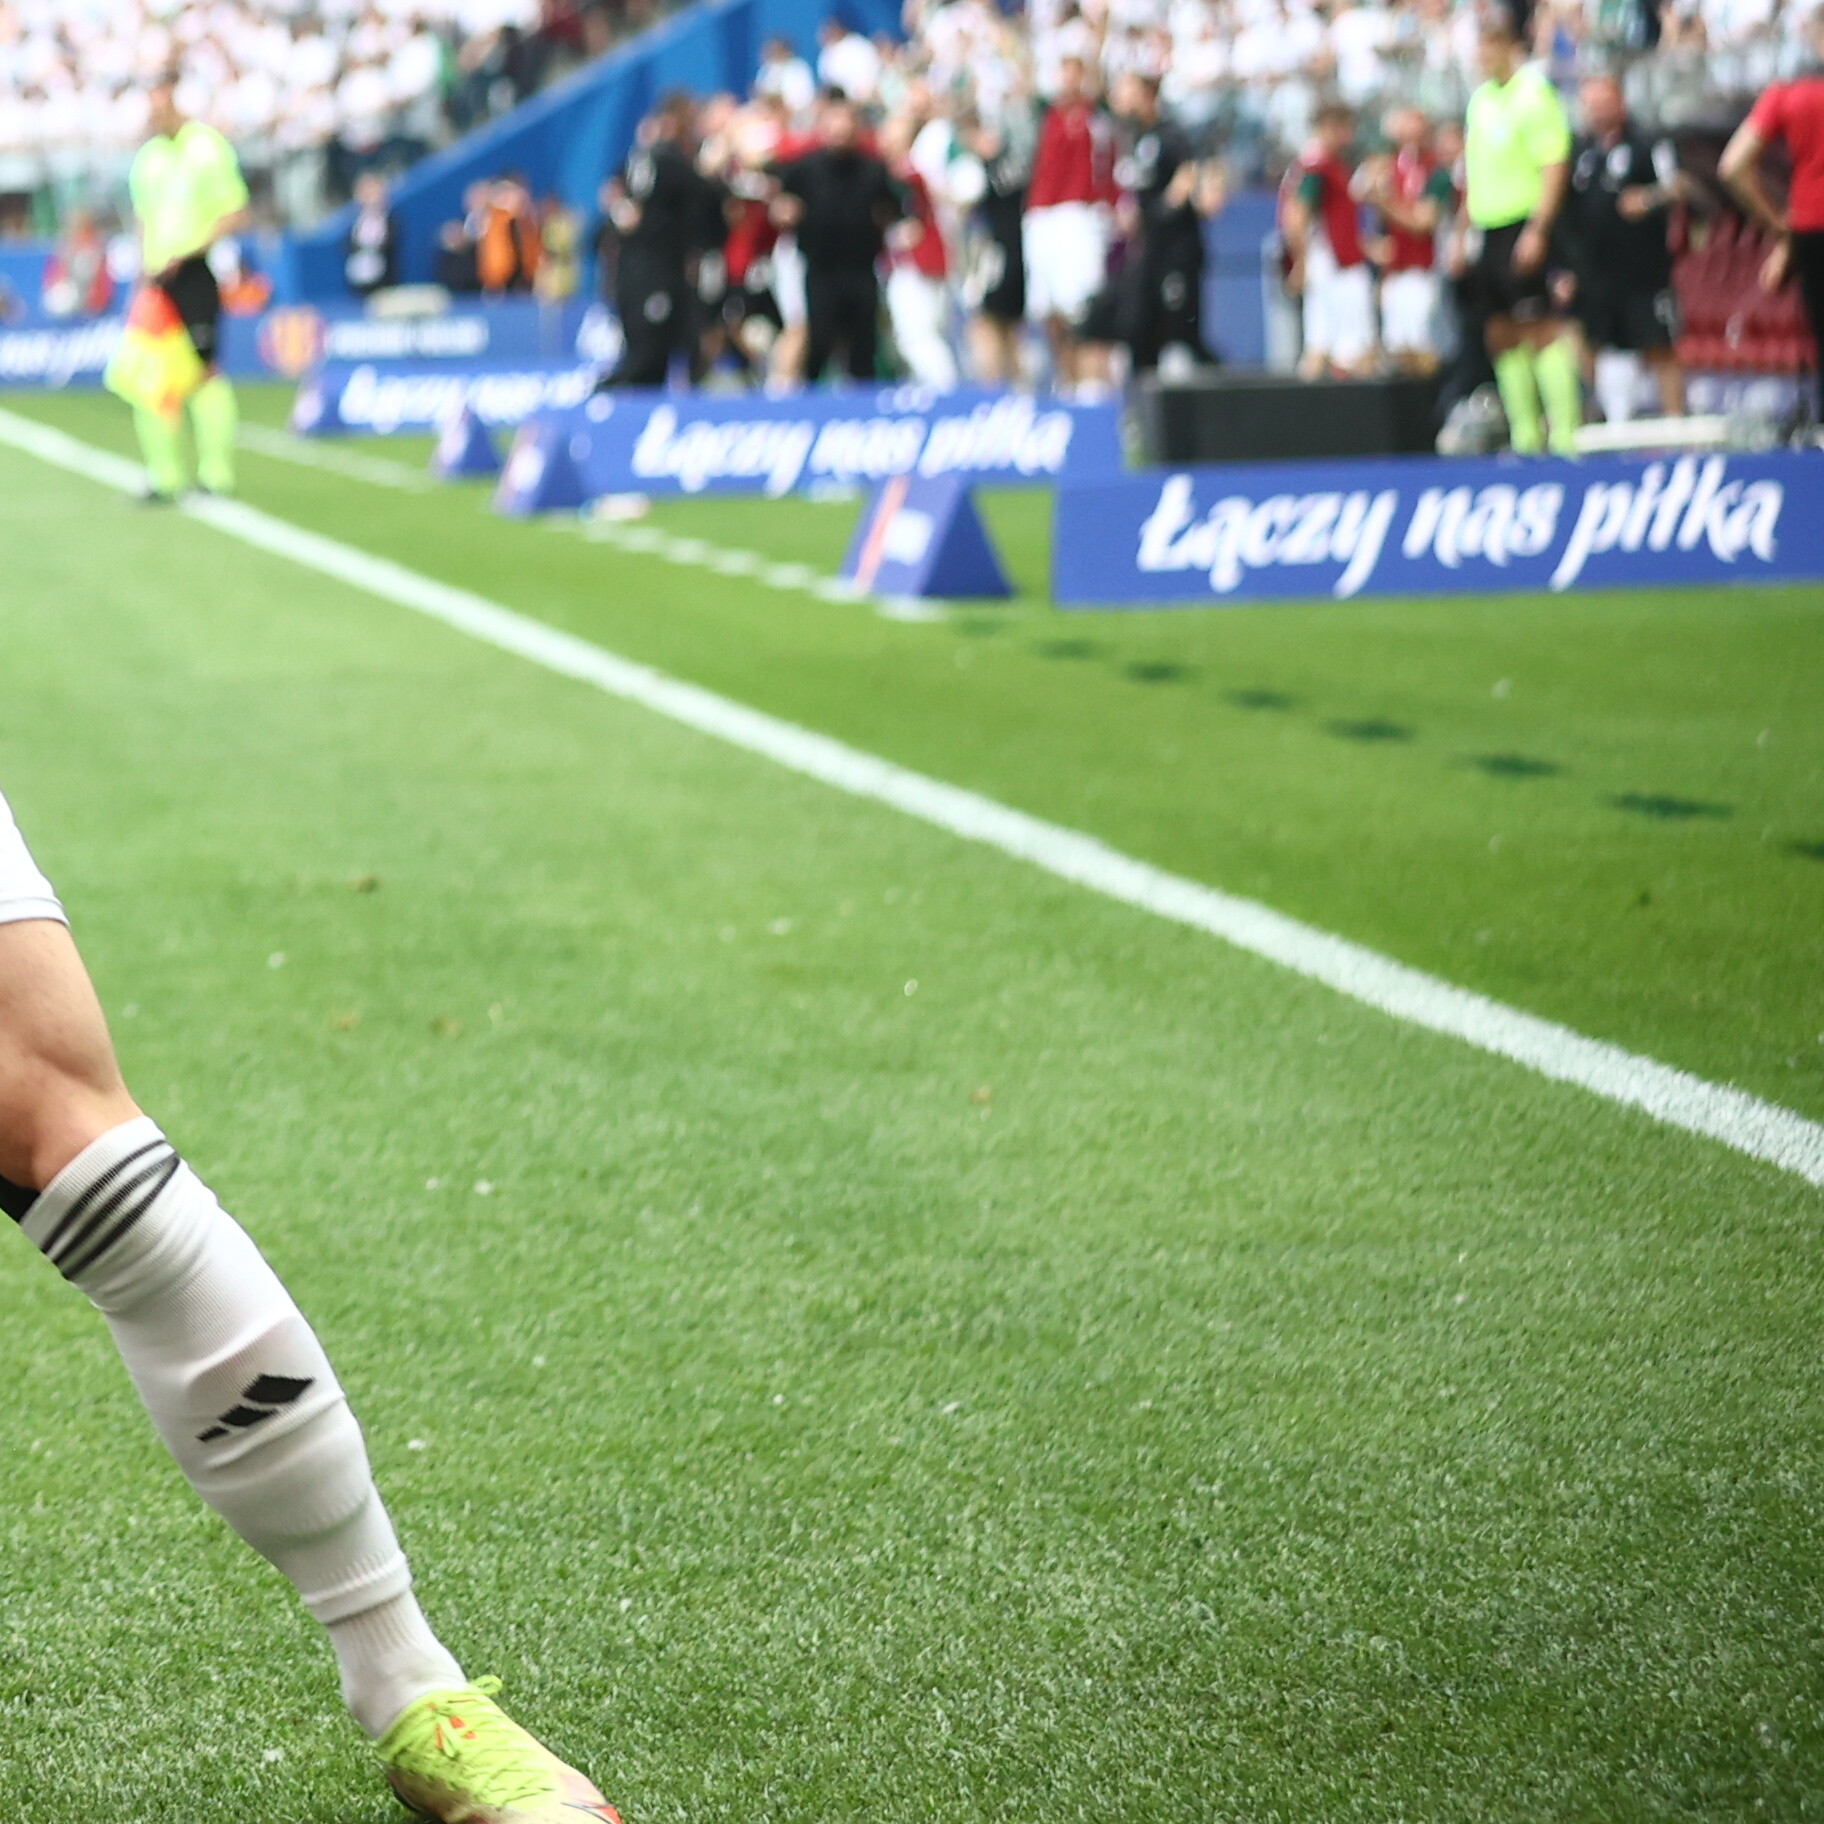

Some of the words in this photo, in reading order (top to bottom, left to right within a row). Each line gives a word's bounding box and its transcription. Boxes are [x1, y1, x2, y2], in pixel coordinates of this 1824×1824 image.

[1137, 473, 1398, 599] Łączy
[1402, 482, 1566, 569] nas
[1549, 453, 1785, 593] piłka
